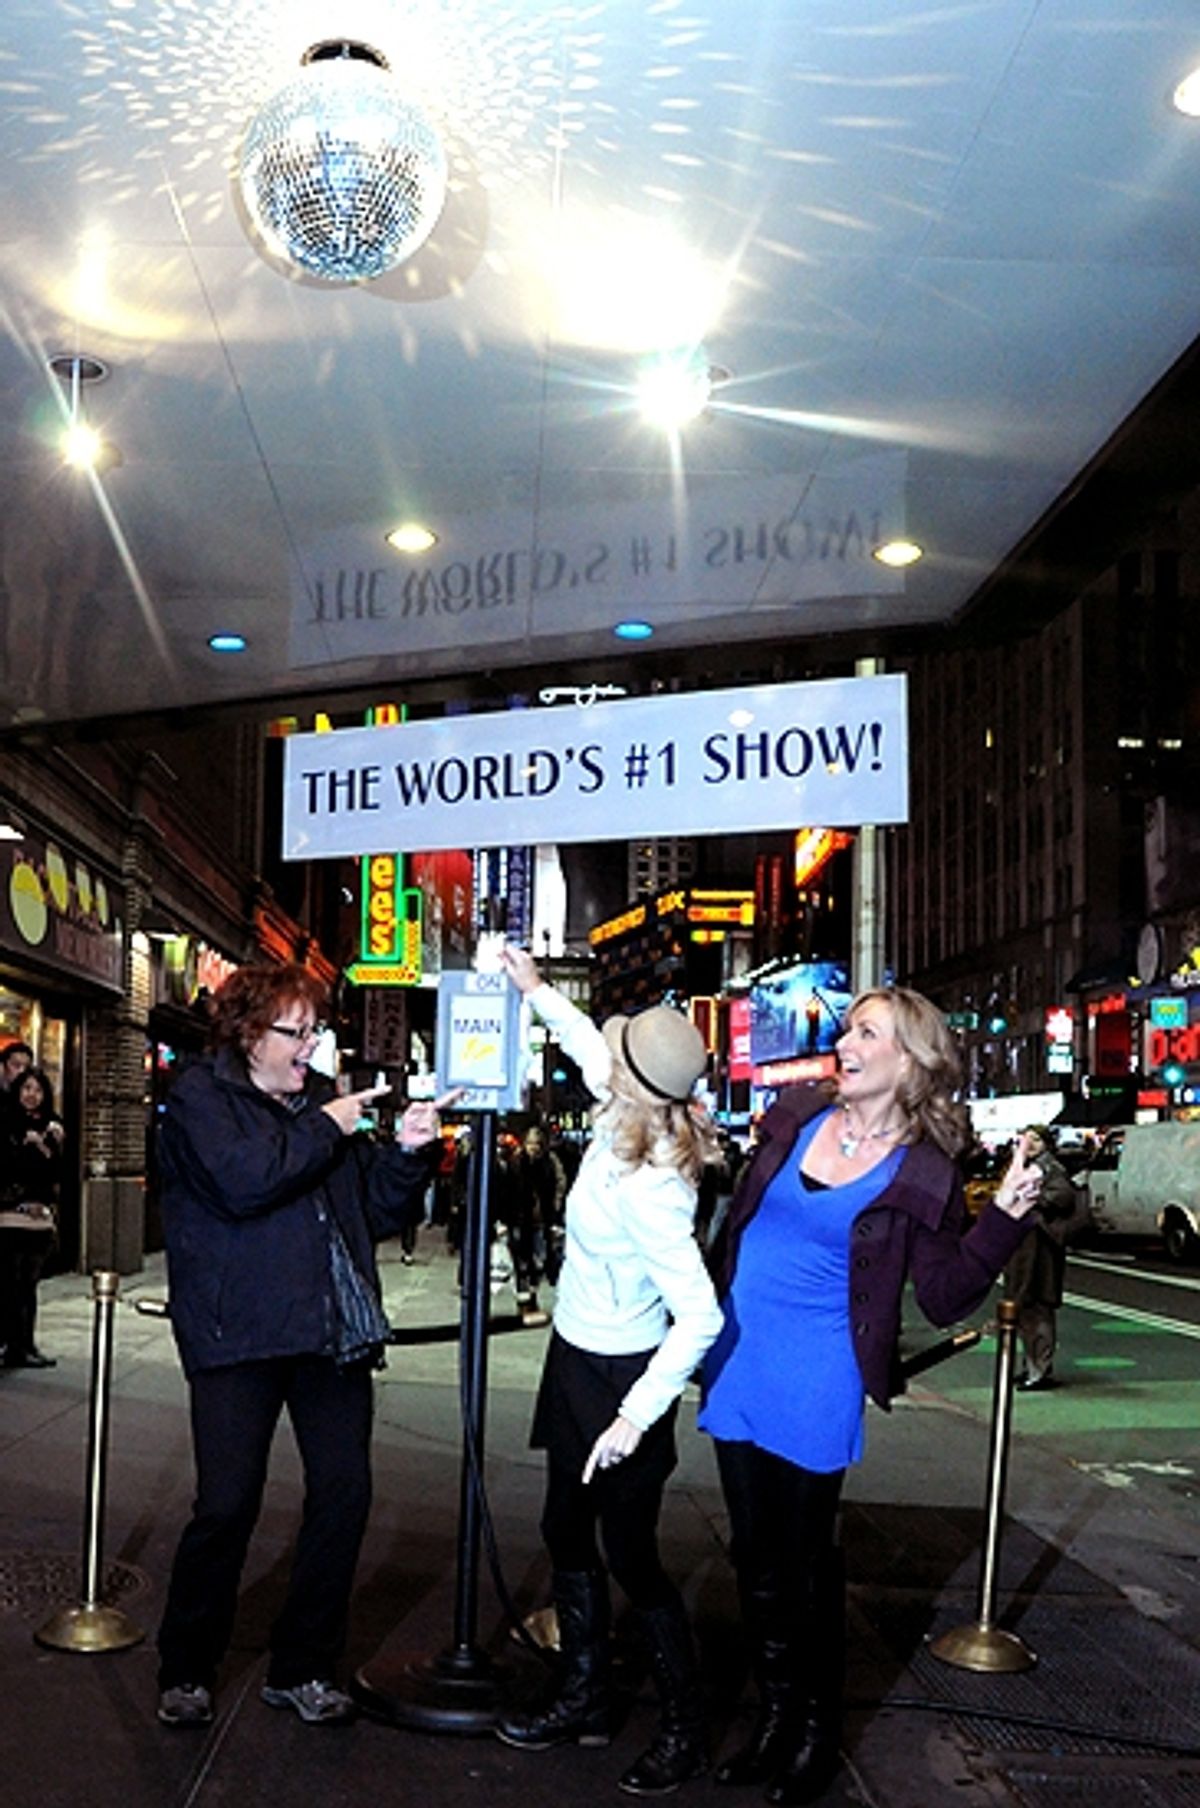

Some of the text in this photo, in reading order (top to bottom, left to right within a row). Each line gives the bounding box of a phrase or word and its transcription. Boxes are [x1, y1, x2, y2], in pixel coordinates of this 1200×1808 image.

[302, 722, 883, 815] THE WORLD'S #1 SHOW!
[453, 1018, 502, 1034] MAIN
